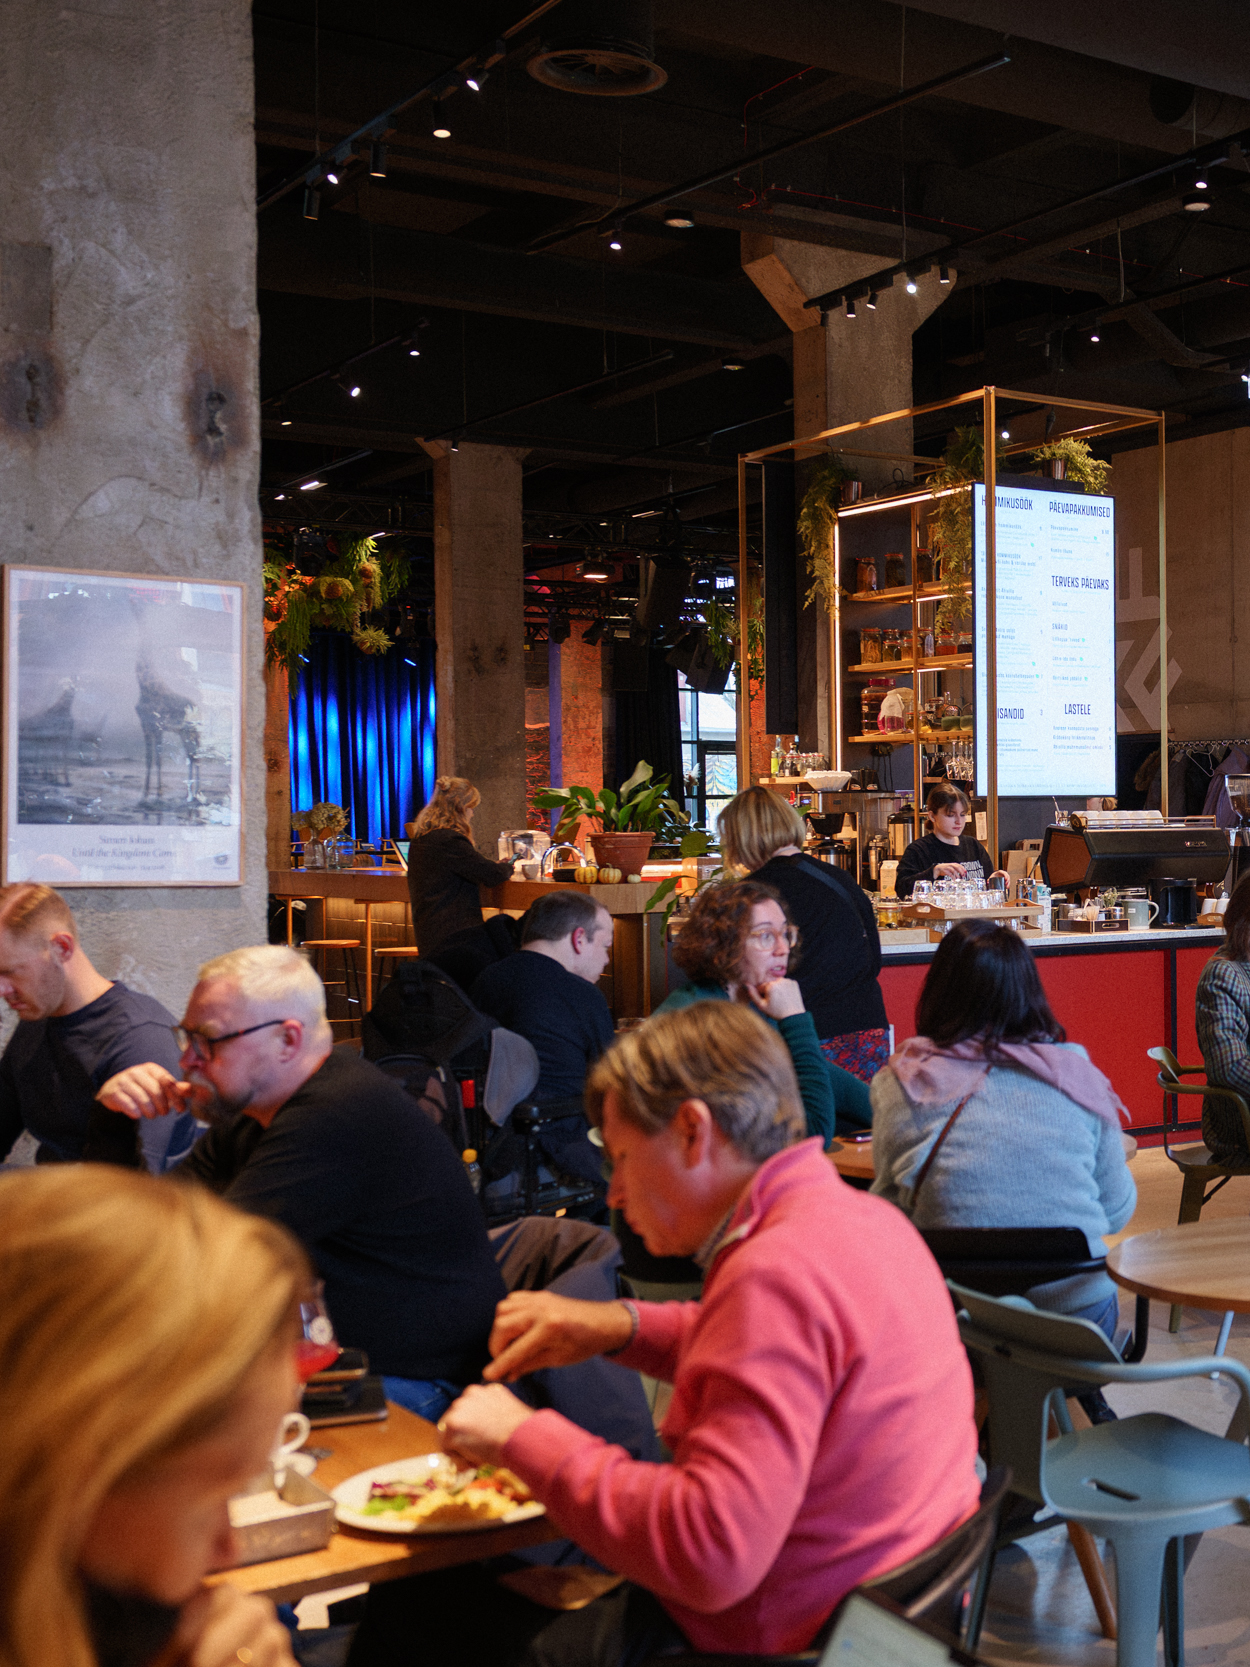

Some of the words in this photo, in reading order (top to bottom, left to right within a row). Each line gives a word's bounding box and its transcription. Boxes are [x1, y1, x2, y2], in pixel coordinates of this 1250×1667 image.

[981, 494, 1033, 511] HMIKUSÖÖK
[1049, 499, 1111, 518] PÄEVAPAKKUMISED
[1051, 575, 1080, 588] TERVEKS
[1081, 575, 1110, 591] PÄEVAKS
[997, 707, 1025, 720] ISANDID
[1064, 703, 1091, 716] LASTELE
